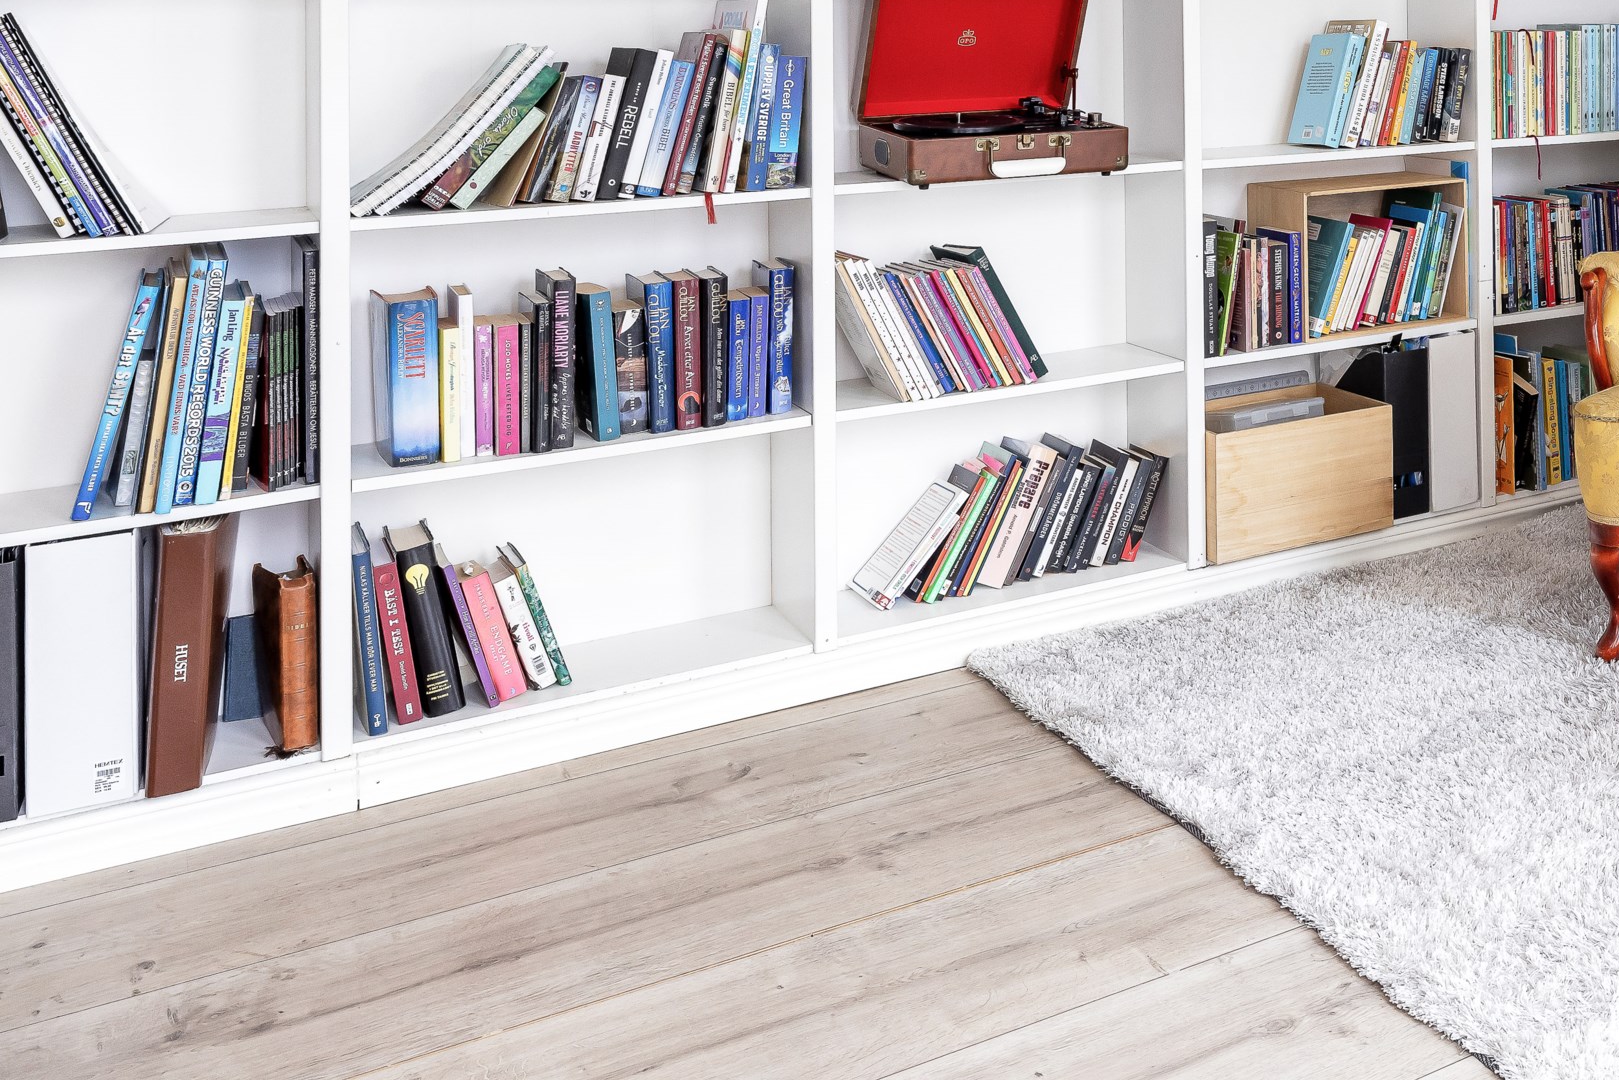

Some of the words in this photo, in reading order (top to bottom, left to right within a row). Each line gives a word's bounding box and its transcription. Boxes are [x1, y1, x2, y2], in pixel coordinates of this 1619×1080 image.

[760, 65, 774, 101] UPPLEV
[1440, 62, 1448, 84] STIEG
[781, 79, 794, 109] Great
[1408, 77, 1418, 110] MESSAGE
[1435, 85, 1446, 118] LARSSON
[615, 105, 639, 149] REBELL
[756, 103, 770, 142] SVERIGE
[779, 112, 793, 148] Britain
[563, 131, 583, 173] BADHYTTEN
[656, 128, 671, 154] BIBEL
[1204, 234, 1217, 254] Young
[1204, 255, 1217, 278] Mungo
[1274, 249, 1282, 275] STEPHEN
[308, 267, 317, 290] PETER
[186, 284, 200, 308] ATLAS
[201, 268, 223, 335] GUINNESS
[308, 291, 317, 314] MADSEN
[554, 290, 570, 318] LIANE
[679, 287, 688, 322] GUILLOU
[688, 295, 696, 311] JAN
[711, 283, 720, 324] GUILLOU
[773, 274, 784, 318] GUILLOU
[783, 286, 791, 305] JAN
[227, 309, 239, 323] Jan
[648, 294, 660, 344] GUILLOU
[660, 307, 670, 329] JAN
[1275, 304, 1283, 328] SHINING
[126, 326, 146, 343] Är
[223, 323, 237, 342] Ling
[397, 311, 426, 379] SCARLETT
[554, 320, 569, 368] MORIARTY
[684, 325, 694, 349] Arvet
[117, 345, 137, 367] det
[180, 325, 195, 368] VETGIRIGA
[193, 336, 214, 382] WORLD
[308, 318, 318, 375] MÄNNISKOSONEN
[684, 351, 694, 368] efter
[177, 374, 189, 390] VAD
[685, 371, 694, 388] Arn
[734, 339, 744, 399] Tempelriddaren
[104, 370, 132, 416] SANT?
[243, 375, 254, 402] BINGOS
[308, 380, 318, 419] BERÄTTELSEN
[173, 391, 186, 414] FINNS
[170, 415, 183, 435] VAR?
[184, 386, 206, 446] RECORDS
[240, 405, 251, 428] BÄSTA
[308, 420, 317, 432] OM
[237, 431, 248, 458] BILDER
[308, 432, 317, 450] JESUS
[180, 447, 196, 477] 2015
[1018, 460, 1050, 509] Prepare
[1038, 492, 1063, 539] DRÖMMEGÅRDEN
[1100, 501, 1123, 546] CHAMPION
[1117, 502, 1136, 543] PRODIGY
[359, 565, 369, 587] NIKLAS
[361, 587, 373, 614] KÄLLNER
[384, 588, 400, 616] BÄST
[364, 615, 373, 631] TILLS
[522, 622, 534, 642] tivoli
[366, 632, 375, 645] MAN
[391, 630, 403, 656] TEST
[489, 625, 512, 676] ENDGAME
[174, 643, 189, 683] HUSET
[367, 646, 376, 659] DÖR
[369, 660, 377, 677] LEVER
[399, 661, 407, 675] David
[370, 679, 378, 692] MAN
[400, 676, 409, 690] Sundin
